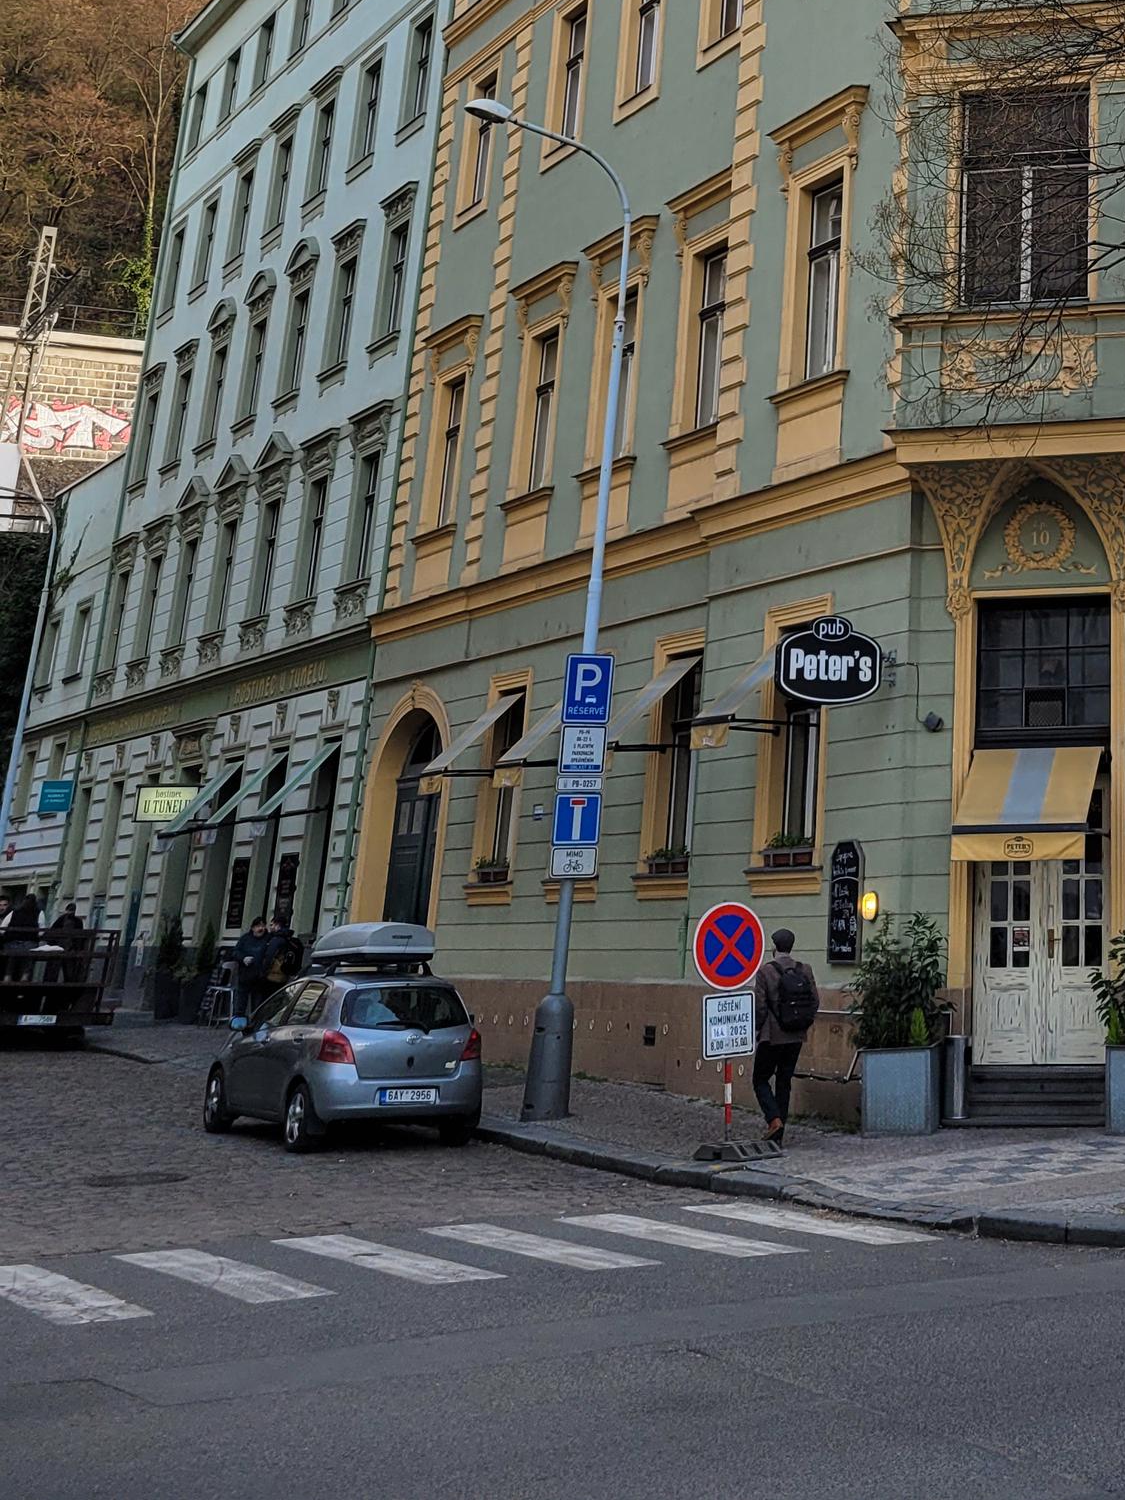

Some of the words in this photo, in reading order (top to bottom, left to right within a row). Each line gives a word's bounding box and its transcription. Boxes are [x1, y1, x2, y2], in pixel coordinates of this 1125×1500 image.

[819, 619, 845, 638] pub
[789, 648, 872, 682] Peter's
[574, 663, 603, 701] P
[567, 706, 605, 716] RÉSERVÉ
[143, 800, 151, 814] U
[566, 850, 584, 858] MIMO
[717, 999, 741, 1012] ČIŠTĚNÍ
[709, 1013, 749, 1025] KOMUNIKACE
[730, 1025, 747, 1036] 2025
[388, 1090, 404, 1101] 6AY
[410, 1090, 432, 1101] 2956
